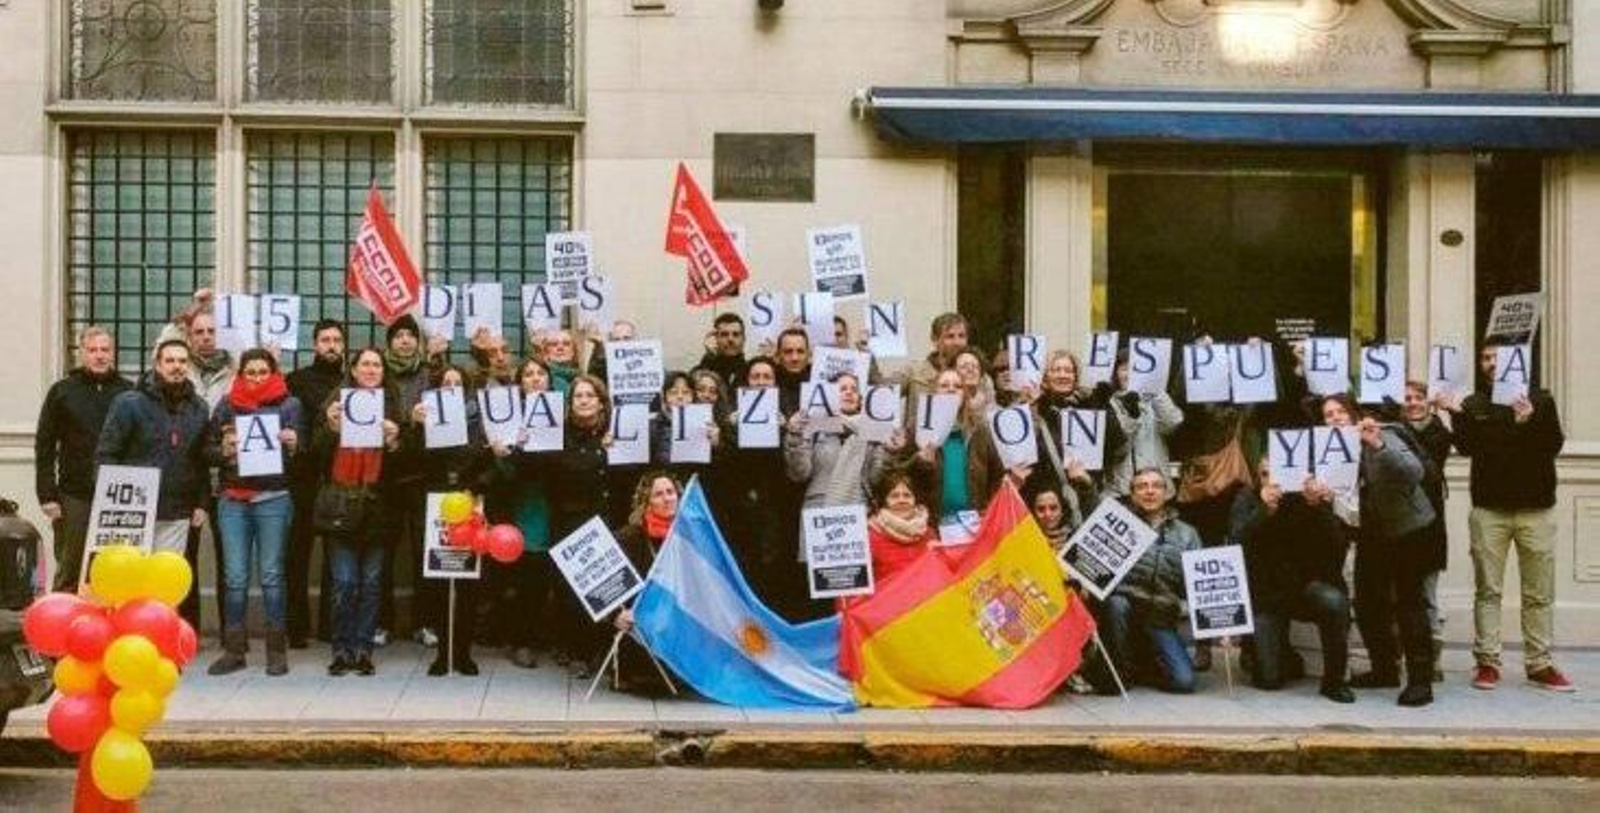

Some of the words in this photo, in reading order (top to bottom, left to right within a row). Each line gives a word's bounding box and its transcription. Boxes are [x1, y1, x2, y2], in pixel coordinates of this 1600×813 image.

[106, 482, 147, 505] 40%
[1105, 511, 1137, 547] 40%
[1195, 560, 1234, 576] 40%
